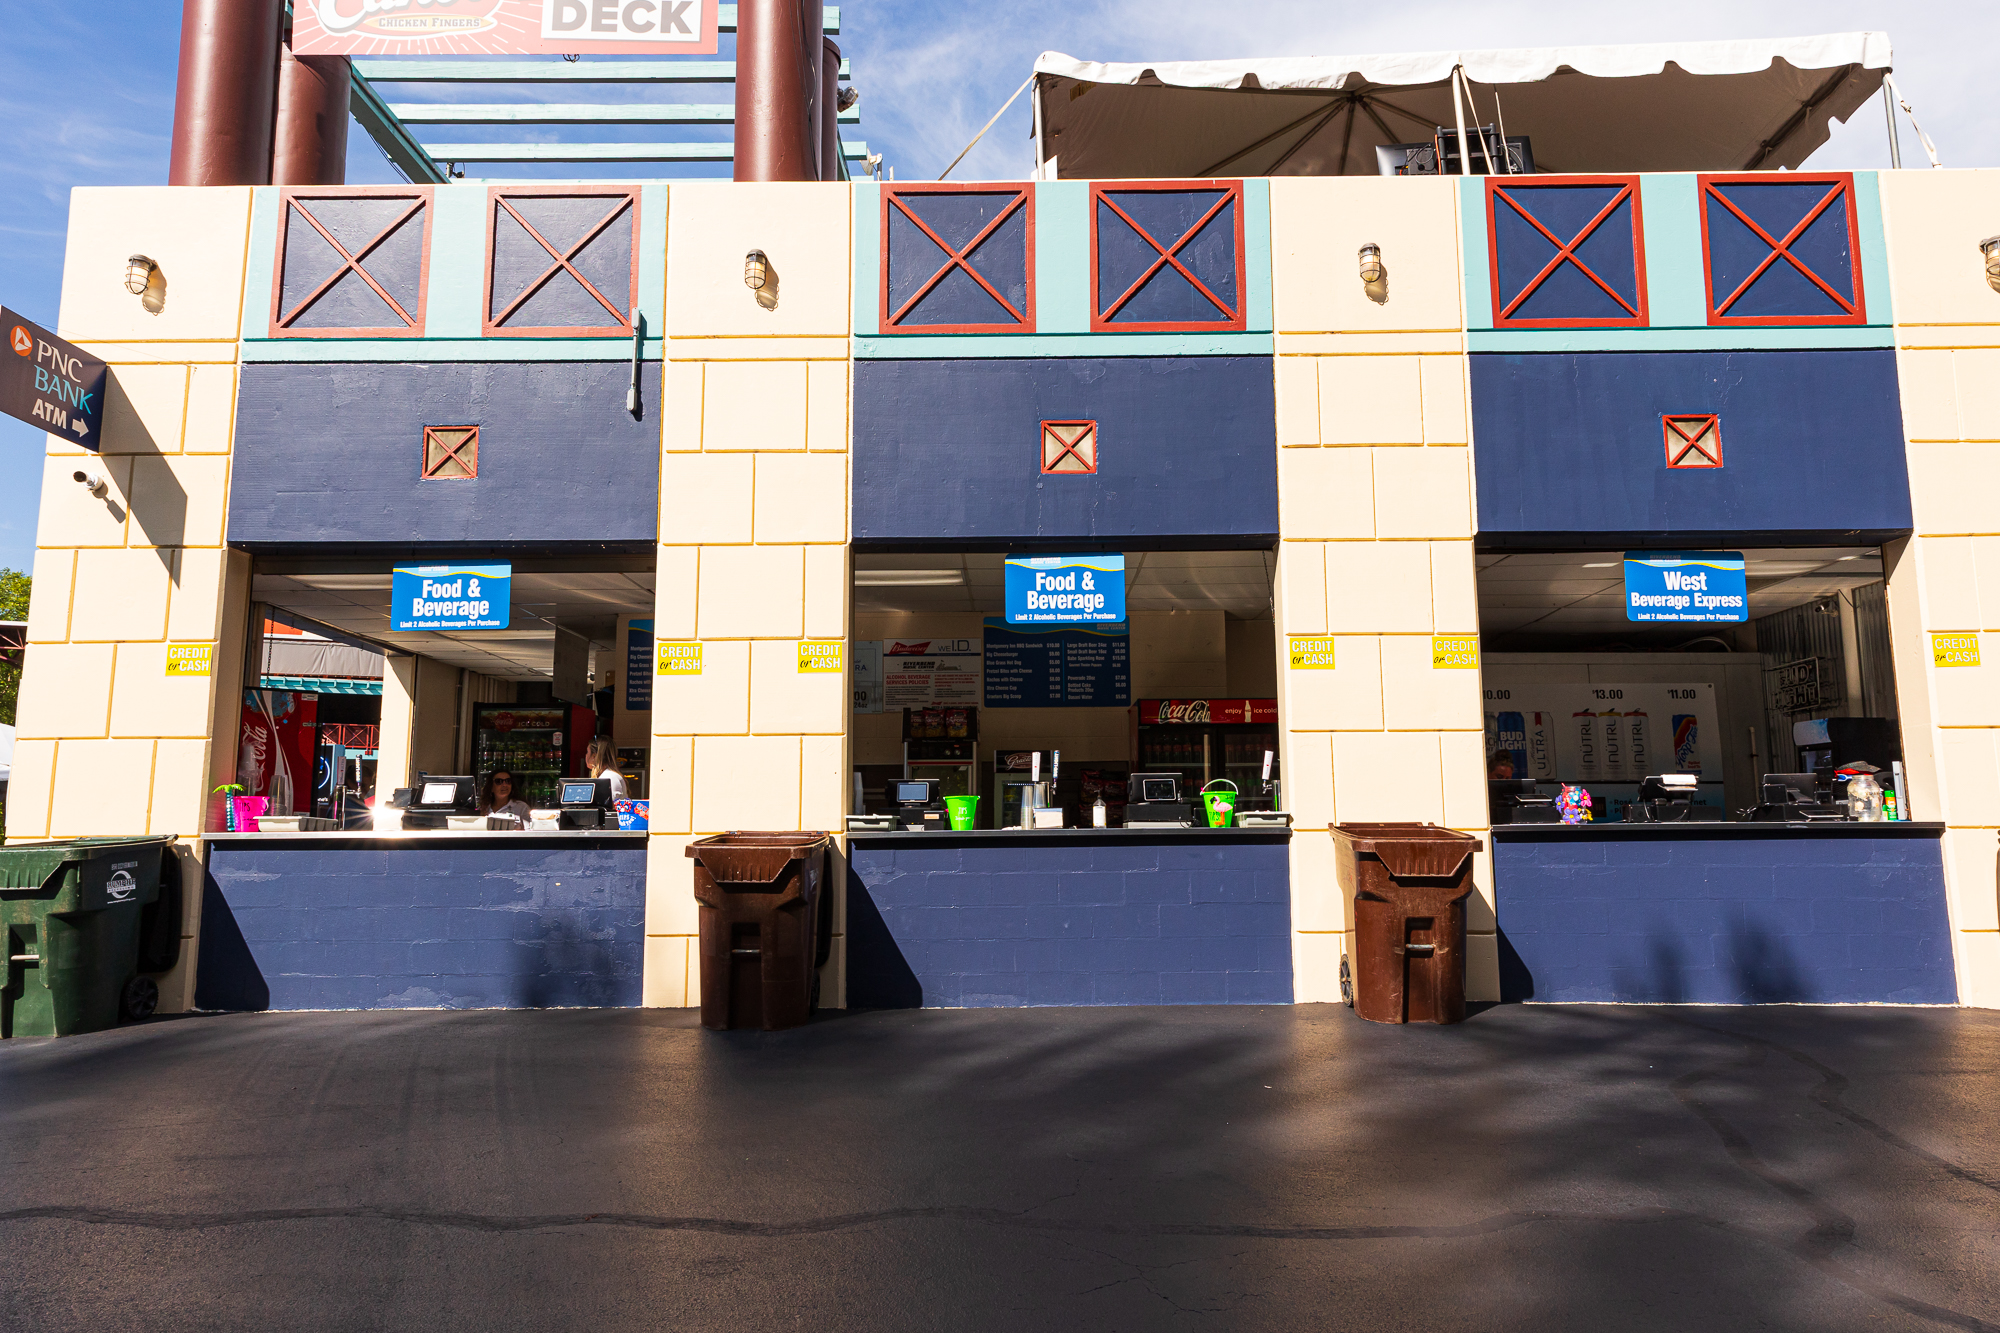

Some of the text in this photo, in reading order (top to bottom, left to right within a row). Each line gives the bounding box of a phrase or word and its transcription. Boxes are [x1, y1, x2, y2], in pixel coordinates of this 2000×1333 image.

[379, 18, 480, 27] CHICKEN FINGERS
[553, 0, 692, 34] DECK
[37, 338, 82, 382] PNC
[34, 365, 93, 414] BANK
[32, 399, 66, 429] ATM
[1036, 571, 1095, 591] Food &
[1663, 571, 1708, 590] West
[422, 578, 481, 598] Food &
[1027, 591, 1104, 613] Beverage
[1631, 592, 1742, 610] Beverage Express
[412, 598, 489, 619] Beverage
[952, 640, 971, 651] I.D.
[1292, 641, 1332, 652] CREDIT
[1435, 641, 1477, 651] CREDIT
[1935, 638, 1977, 649] CREDIT
[170, 647, 210, 659] CREDIT
[660, 646, 700, 658] CREDIT
[801, 644, 840, 656] CREDIT
[811, 657, 840, 668] CASH
[1304, 653, 1333, 665] CASH
[1445, 654, 1476, 664] CASH
[1946, 651, 1978, 662] CASH
[180, 660, 209, 671] CASH
[671, 659, 700, 670] CASH
[1483, 690, 1510, 699] 10.00
[1592, 690, 1623, 699] $13.00
[1668, 689, 1696, 699] $11.00
[1159, 700, 1210, 724] Coca-Cola
[1500, 731, 1523, 740] BUD
[1498, 741, 1526, 750] LIGHT
[1535, 730, 1546, 770] ULTRA
